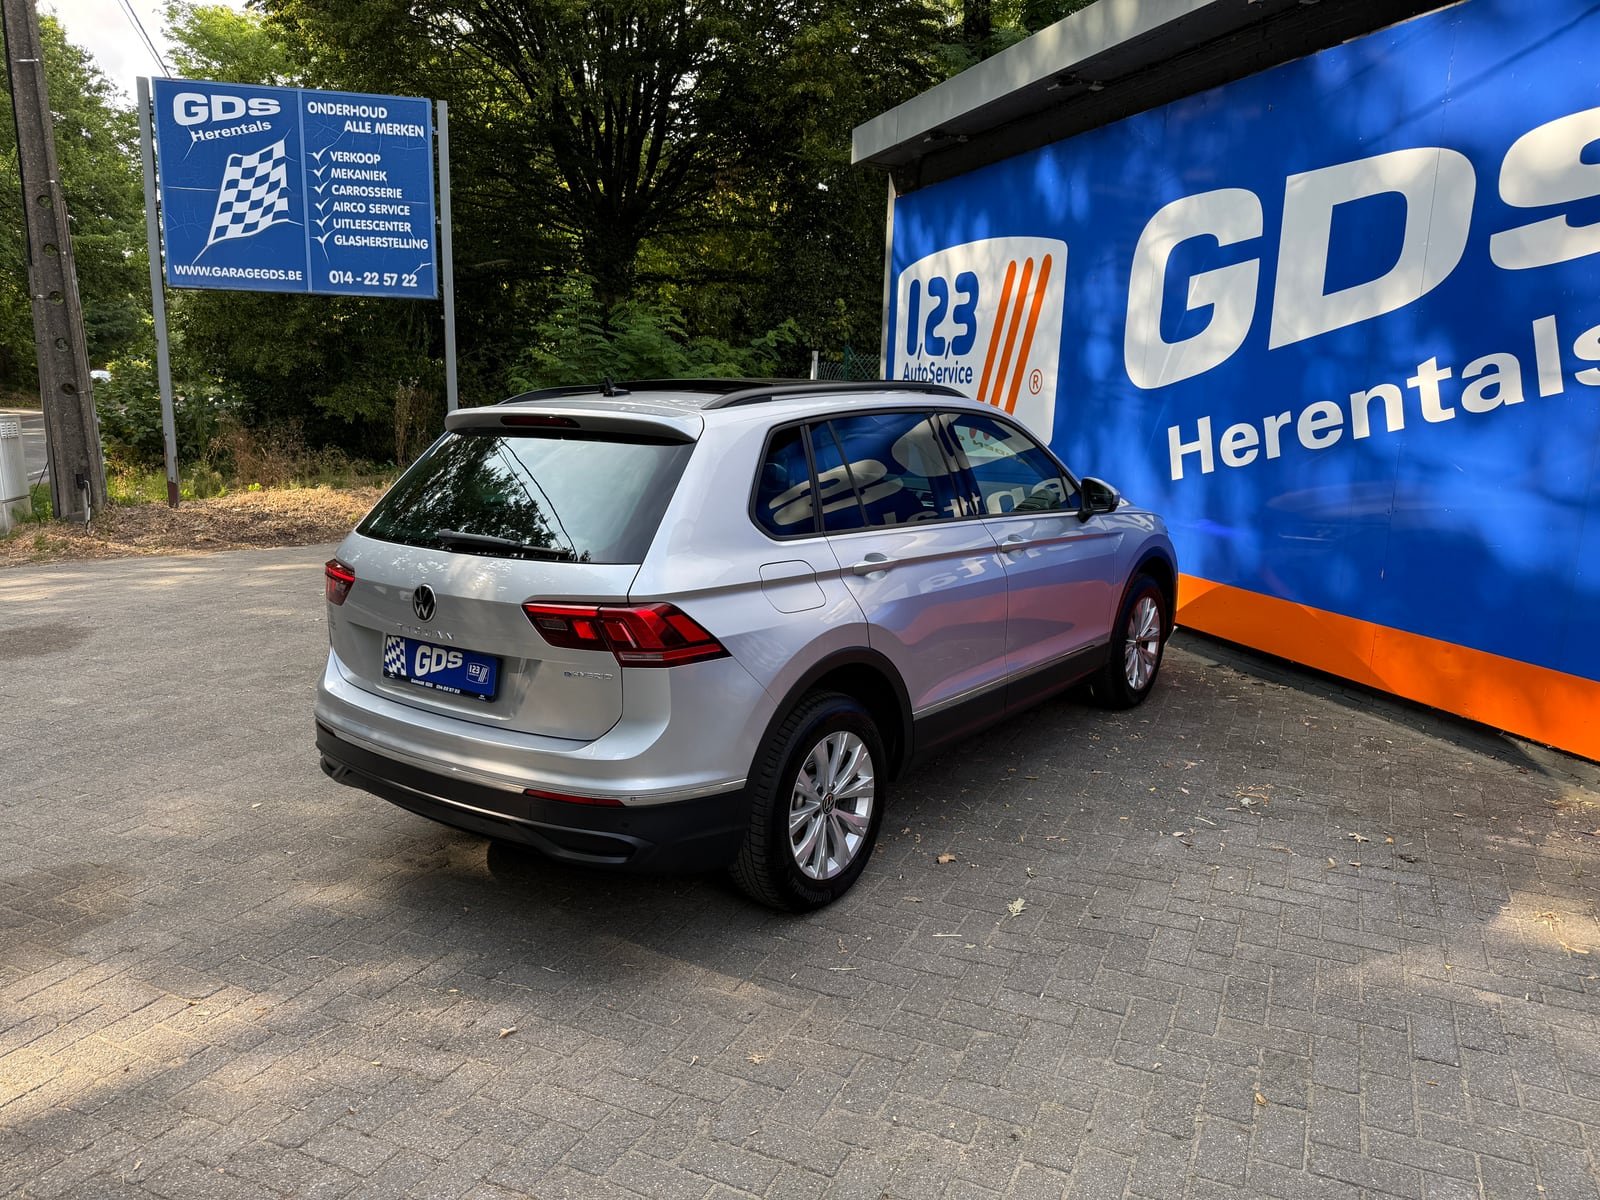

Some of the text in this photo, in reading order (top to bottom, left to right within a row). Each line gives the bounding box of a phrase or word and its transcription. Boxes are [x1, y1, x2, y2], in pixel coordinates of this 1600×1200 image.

[173, 92, 281, 126] GDS
[307, 101, 388, 119] ONDERHOUD
[191, 120, 272, 142] Herentals
[344, 120, 425, 137] ALLE MERKEN
[330, 150, 381, 165] VERKOOP
[331, 167, 387, 182] MEKANIEK
[331, 184, 403, 199] CARROSSERIE
[333, 201, 411, 216] AIRCO SERVICE
[333, 218, 412, 233] UITLEESCENTER
[334, 234, 429, 250] GLASHERSTELLING
[173, 263, 303, 281] WWW.GARAGEGDS.BE
[363, 271, 380, 286] 22
[383, 273, 398, 287] 57
[401, 273, 418, 288] 22
[414, 645, 463, 677] GDS
